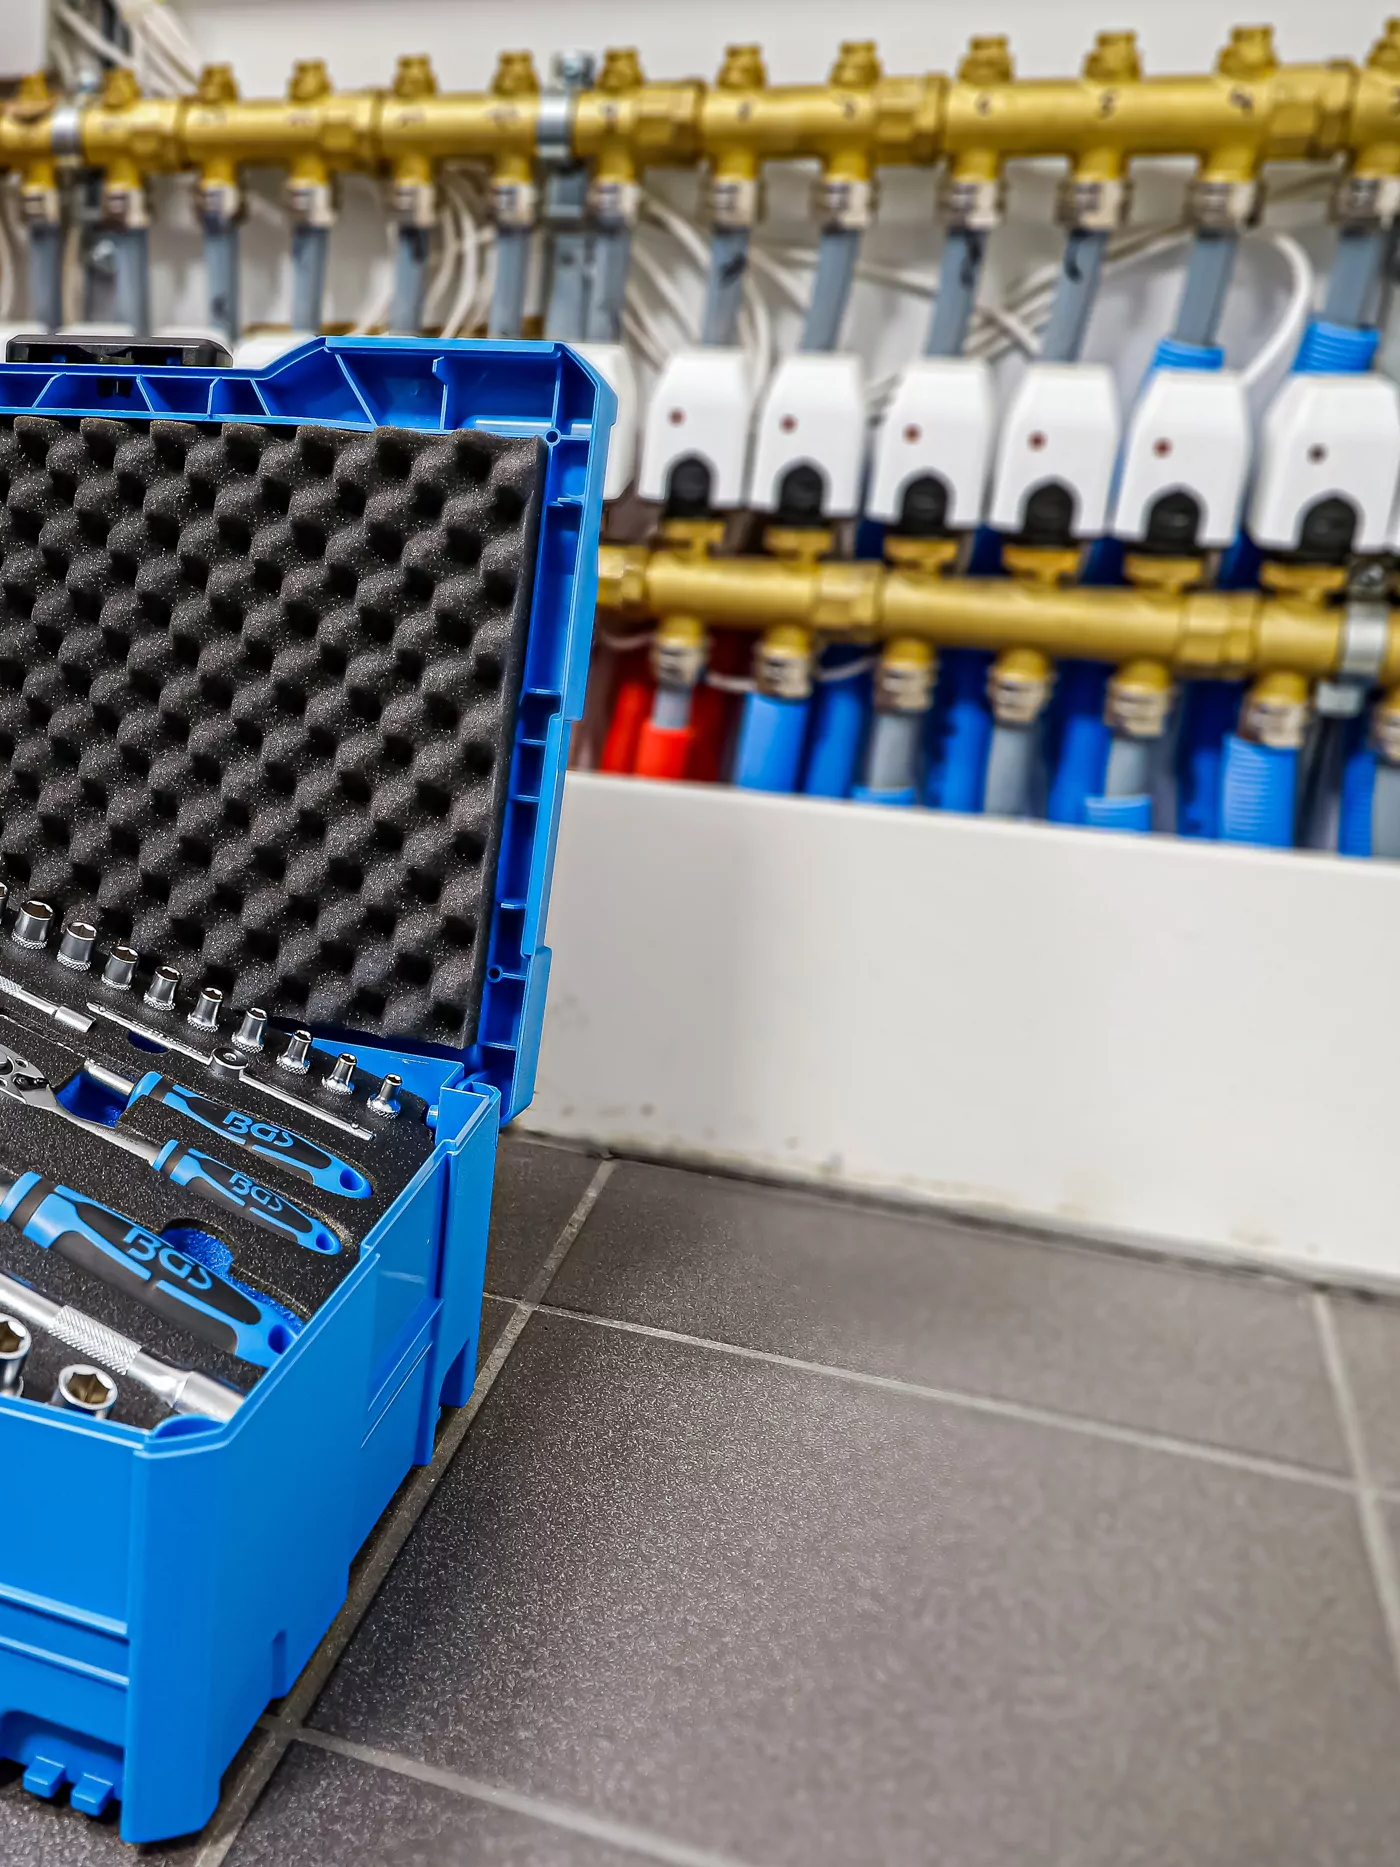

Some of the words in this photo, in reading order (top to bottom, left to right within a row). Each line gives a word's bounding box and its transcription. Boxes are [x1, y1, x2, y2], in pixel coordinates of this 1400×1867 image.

[222, 1110, 295, 1148] BGS
[228, 1171, 284, 1213] BGS
[122, 1226, 213, 1291] BGS
